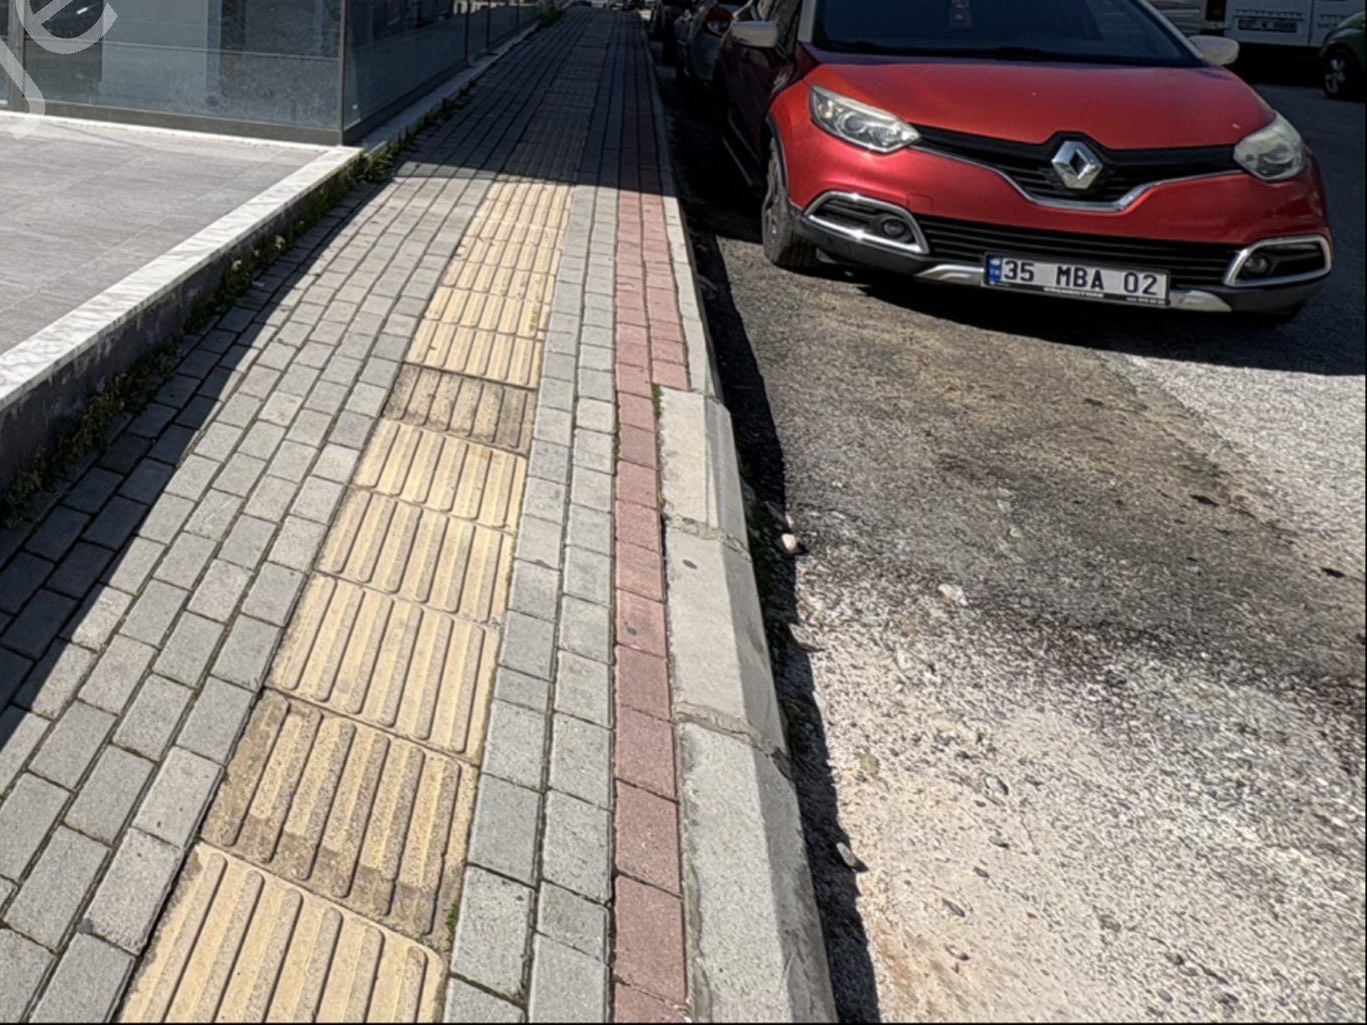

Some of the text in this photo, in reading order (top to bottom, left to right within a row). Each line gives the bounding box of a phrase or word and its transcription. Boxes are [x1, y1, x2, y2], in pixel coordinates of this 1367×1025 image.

[1004, 260, 1034, 282] 35
[1055, 265, 1104, 290] MBA
[1124, 272, 1157, 295] 02
